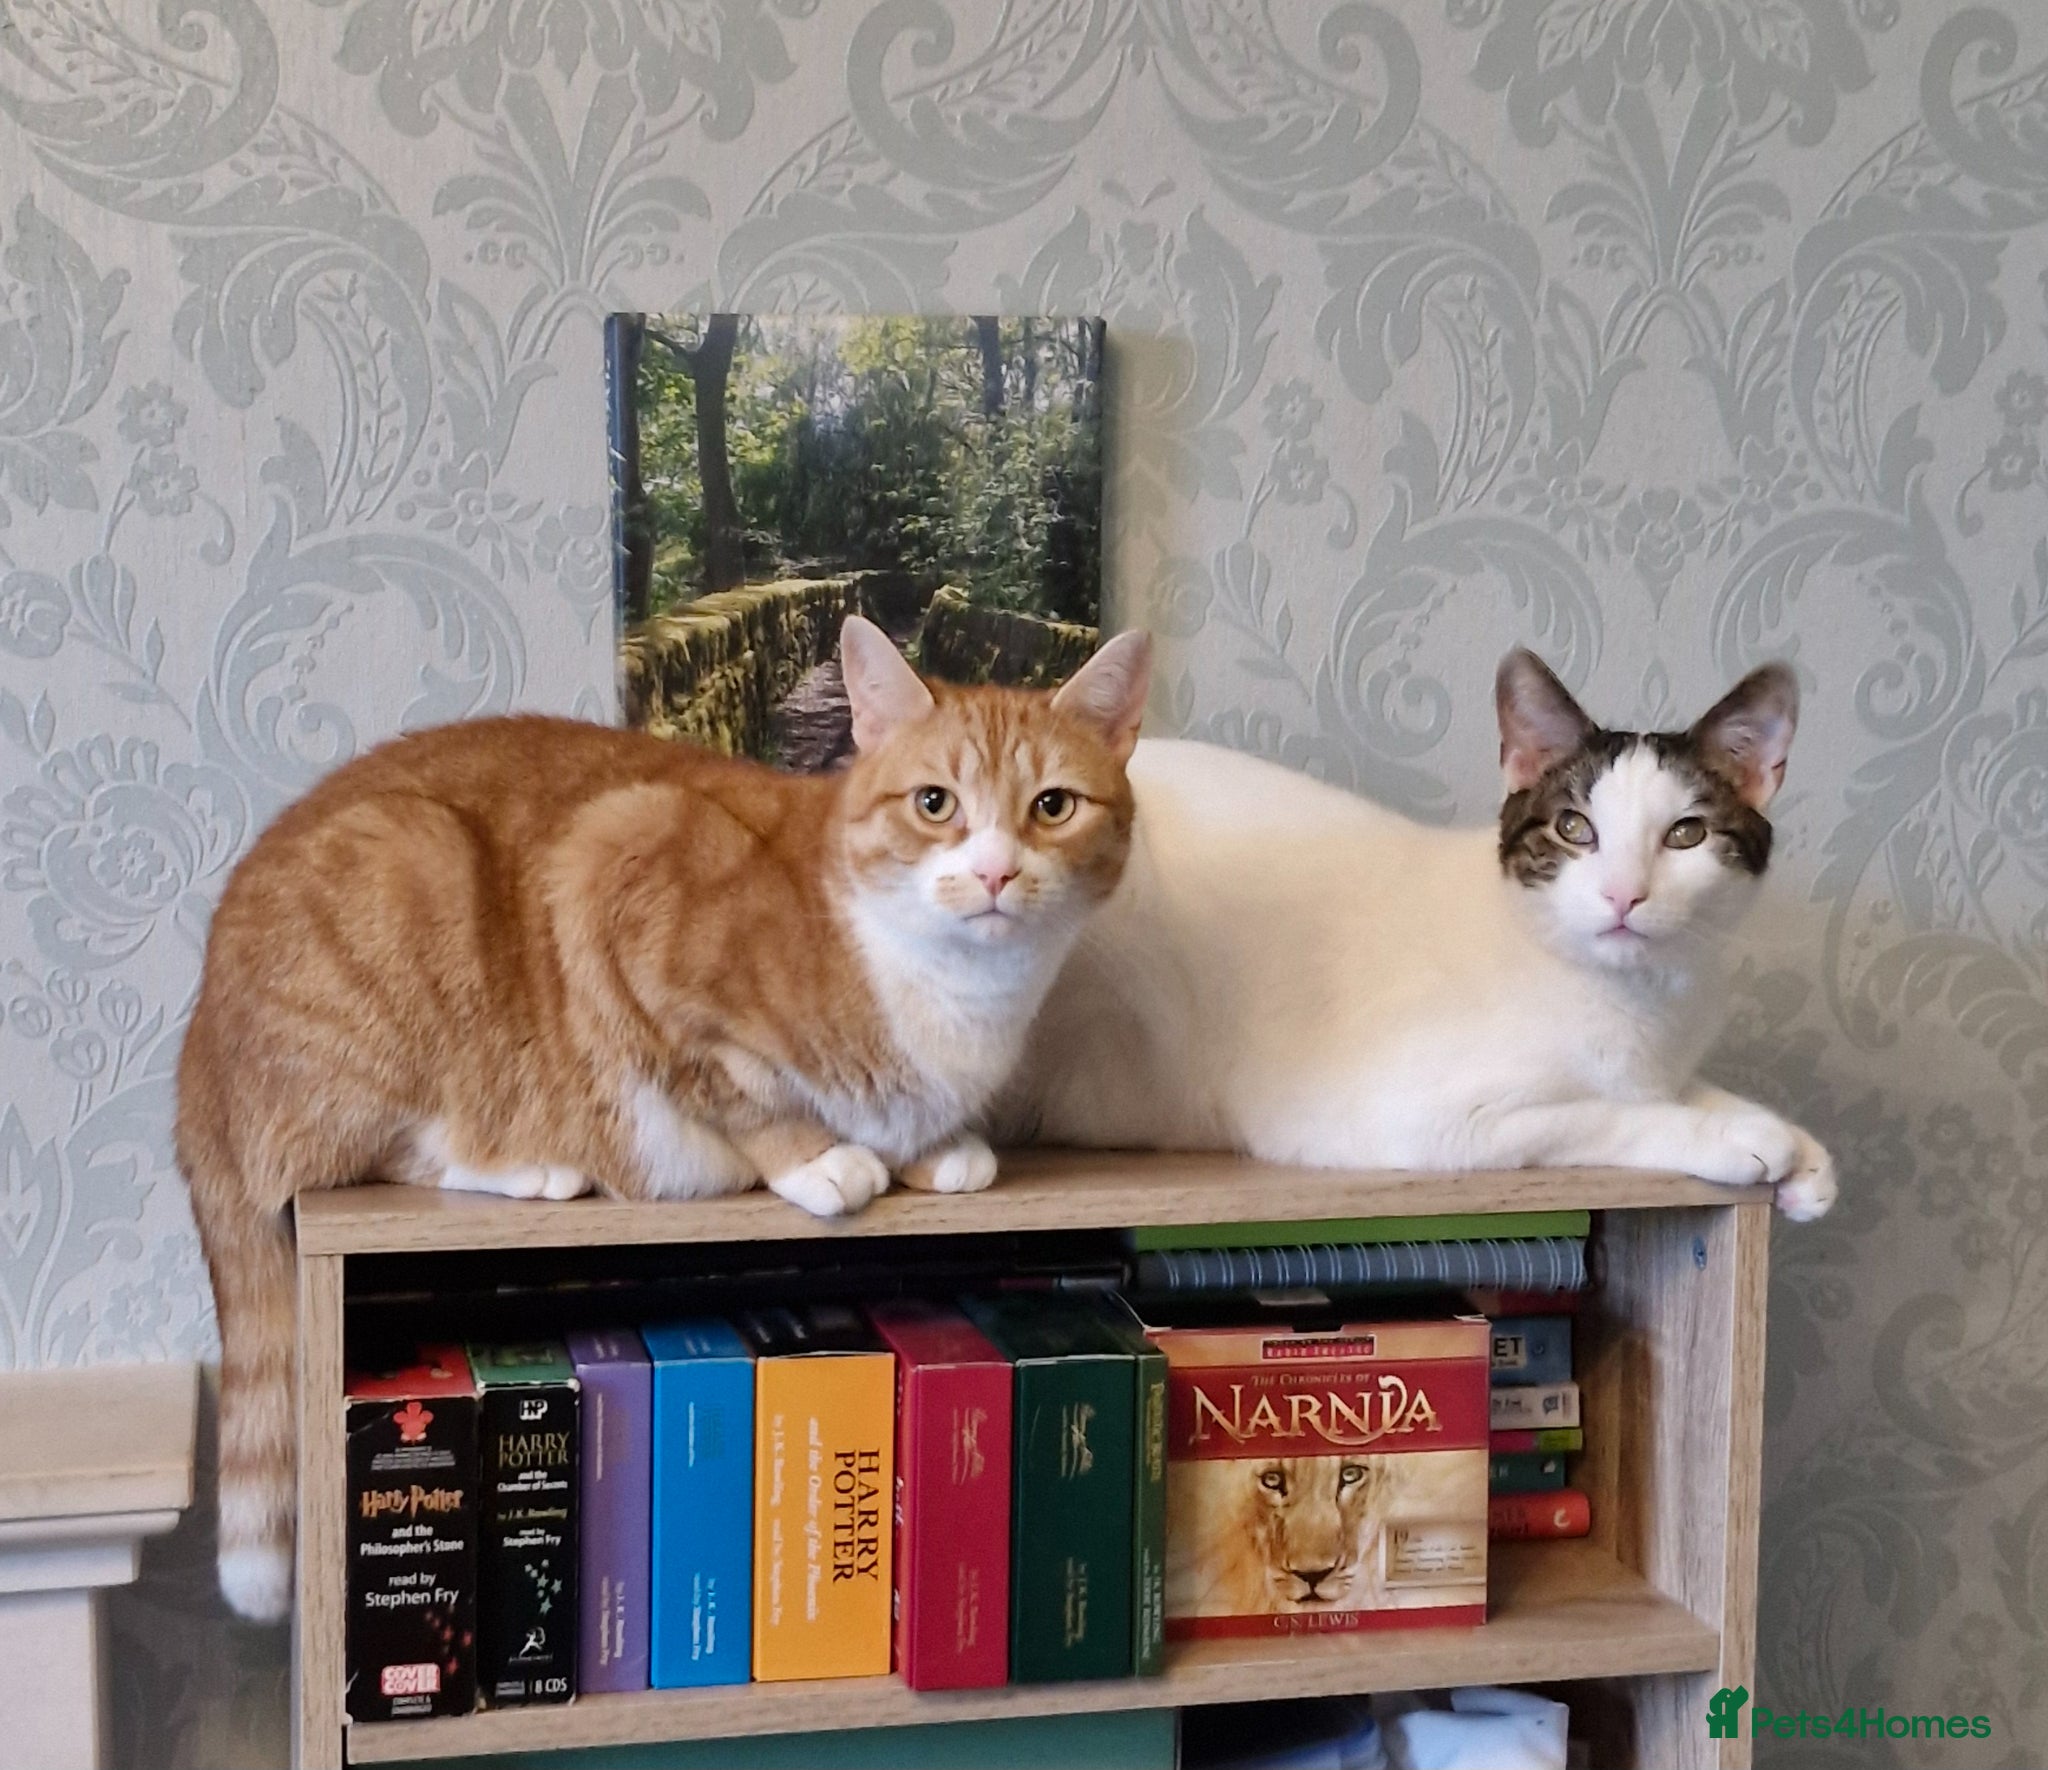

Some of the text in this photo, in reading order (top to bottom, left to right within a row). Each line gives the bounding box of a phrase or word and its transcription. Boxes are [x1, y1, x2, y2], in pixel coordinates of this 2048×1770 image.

[1189, 1375, 1443, 1446] NARNIA
[808, 1417, 823, 1446] and
[499, 1432, 570, 1452] HARRY
[499, 1450, 569, 1469] POTTER
[808, 1450, 823, 1471] the
[361, 1484, 464, 1518] Harry Potter
[808, 1475, 822, 1518] Order
[833, 1450, 856, 1583] POTTER
[857, 1448, 881, 1581] HARRY
[391, 1523, 434, 1539] and the
[803, 1520, 822, 1539] of
[360, 1538, 464, 1558] Philosopher's Stone
[545, 1534, 562, 1546] Fry
[388, 1571, 437, 1588] read by
[365, 1587, 460, 1611] Stephen Fry
[1307, 1613, 1360, 1628] LEWIS
